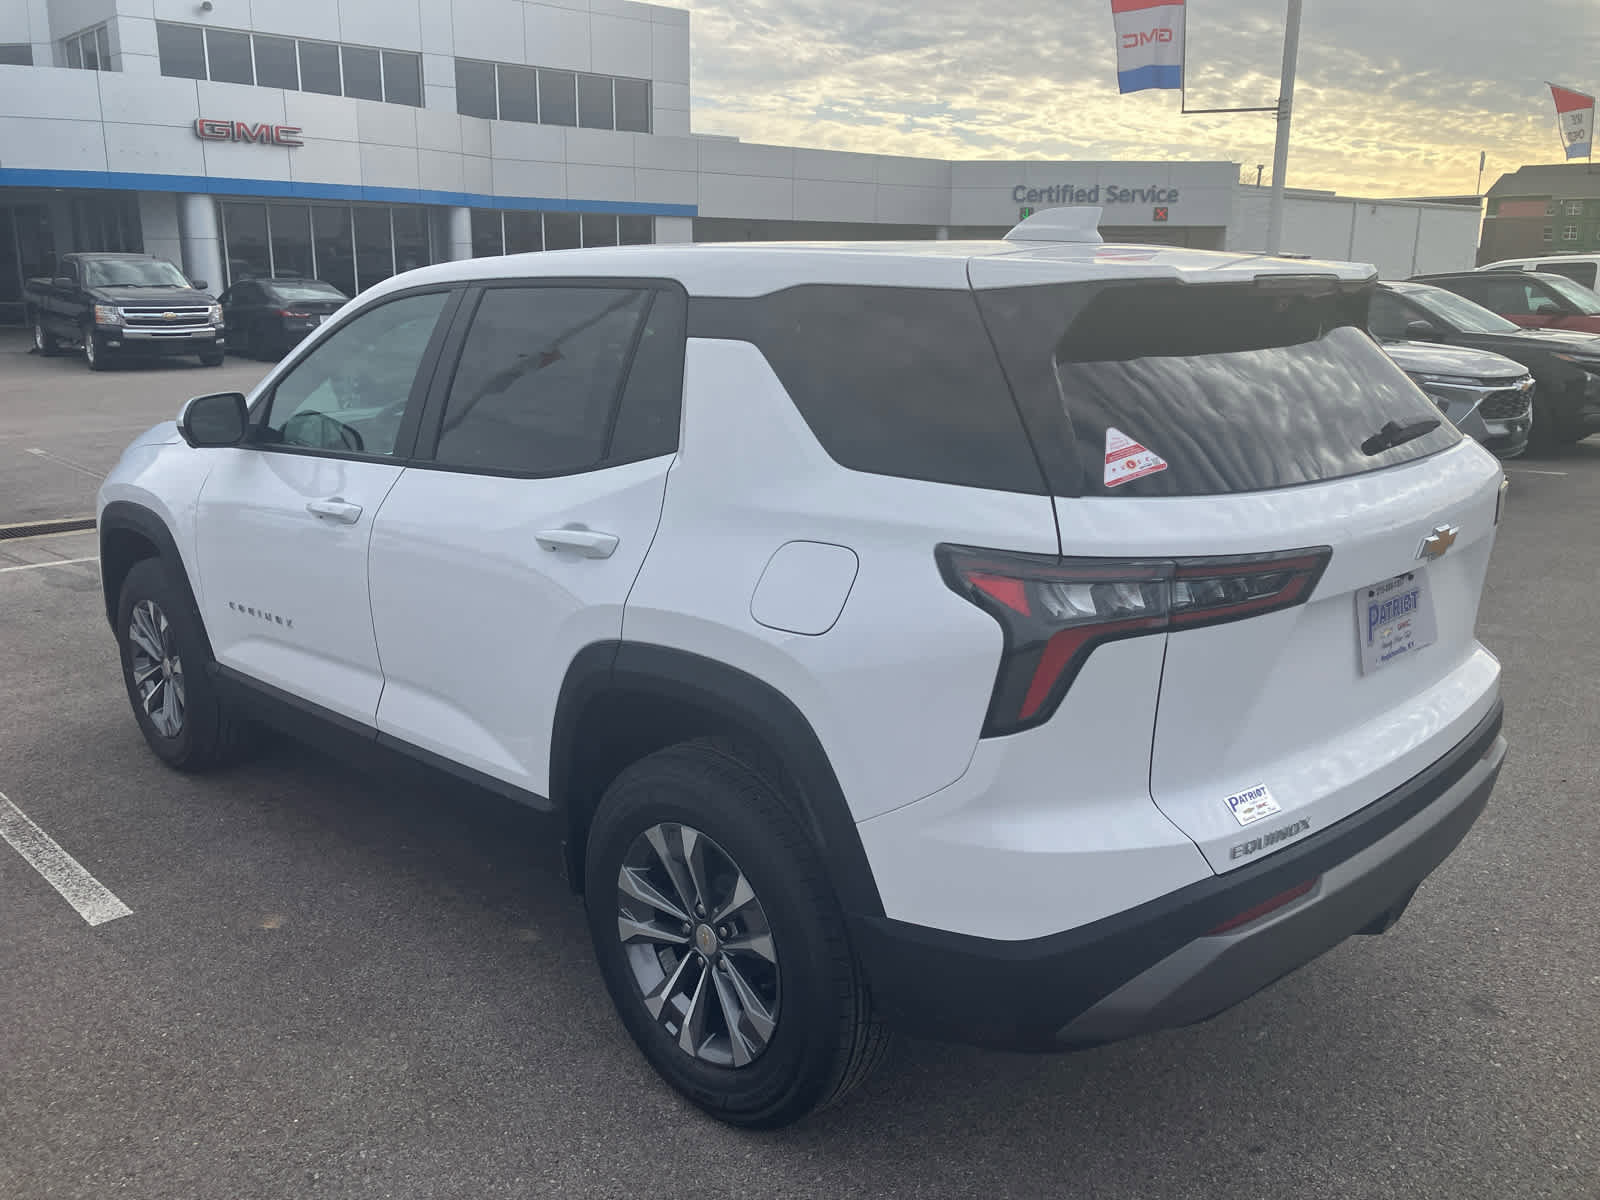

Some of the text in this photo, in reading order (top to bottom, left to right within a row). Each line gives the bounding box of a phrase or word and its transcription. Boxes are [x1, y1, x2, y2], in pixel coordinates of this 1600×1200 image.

[192, 118, 304, 148] GMC
[1012, 184, 1180, 204] Certified Service
[1368, 590, 1419, 641] PATRIOT
[1227, 786, 1268, 813] PATRIOT
[1229, 816, 1312, 860] EQUINOX
